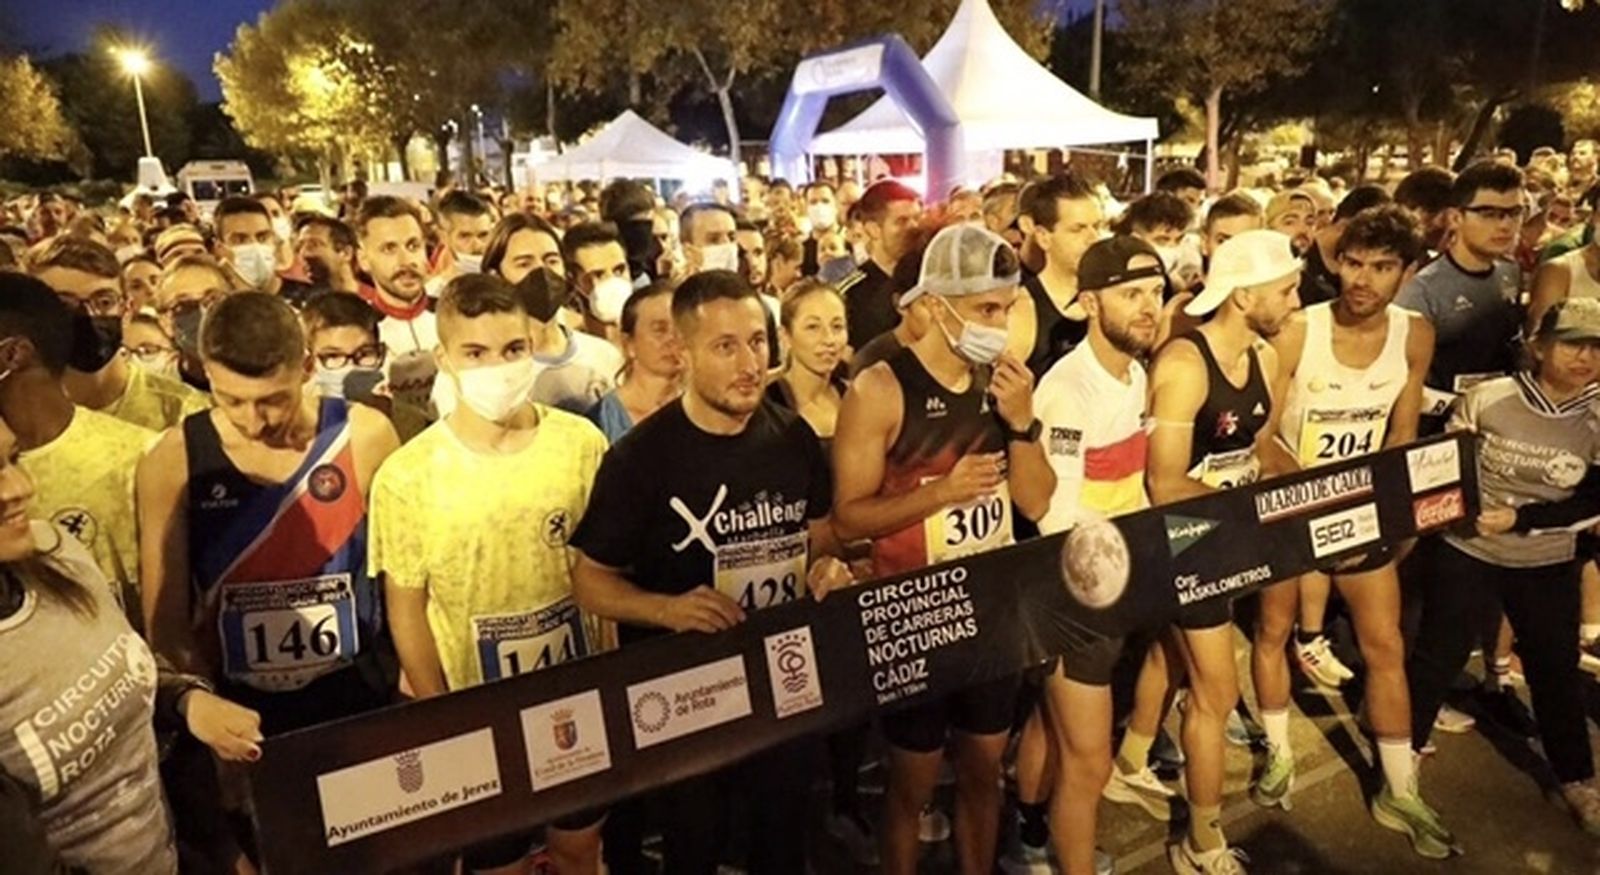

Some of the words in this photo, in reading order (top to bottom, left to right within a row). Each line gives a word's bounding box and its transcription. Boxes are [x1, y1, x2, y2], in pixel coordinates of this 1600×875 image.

[1317, 429, 1374, 459] 204
[1258, 482, 1309, 515] DIARIO
[1311, 477, 1330, 499] DE
[945, 496, 1004, 546] 309
[1314, 519, 1355, 548] SER
[739, 572, 797, 610] 428
[858, 566, 968, 607] CIRCUITO
[861, 585, 970, 626] PROVINCIAL
[248, 613, 339, 664] 146
[865, 624, 888, 644] DE
[890, 600, 974, 637] CARRERAS
[868, 618, 978, 666] NOCTURNAS
[502, 632, 576, 675] 144
[872, 657, 929, 691] CÁDIZ
[33, 633, 131, 728] CIRCUITO
[692, 696, 716, 713] Rota
[59, 724, 117, 783] ROTA
[327, 798, 439, 839] Ayuntamiento
[441, 791, 459, 806] de
[461, 779, 499, 801] Jerez
